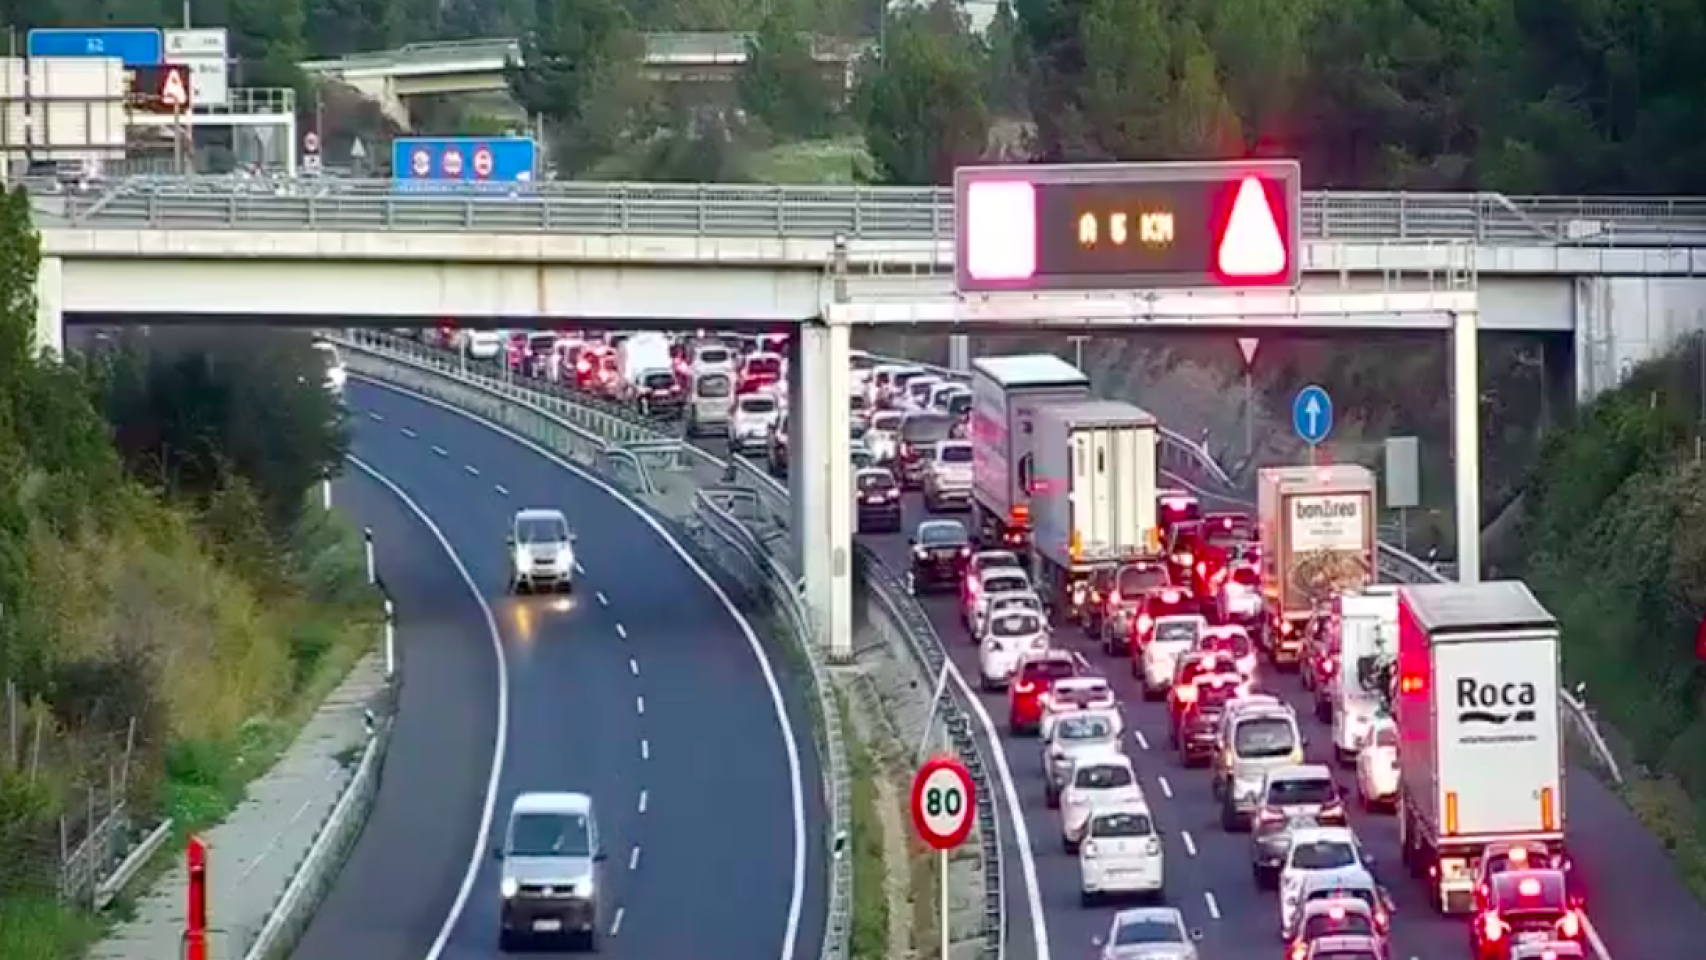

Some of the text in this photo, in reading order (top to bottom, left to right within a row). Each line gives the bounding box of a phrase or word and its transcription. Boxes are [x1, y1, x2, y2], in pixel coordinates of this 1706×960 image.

[1079, 212, 1097, 243] A
[1140, 212, 1173, 242] KM
[1457, 677, 1535, 707] Roca
[927, 788, 961, 816] 80
